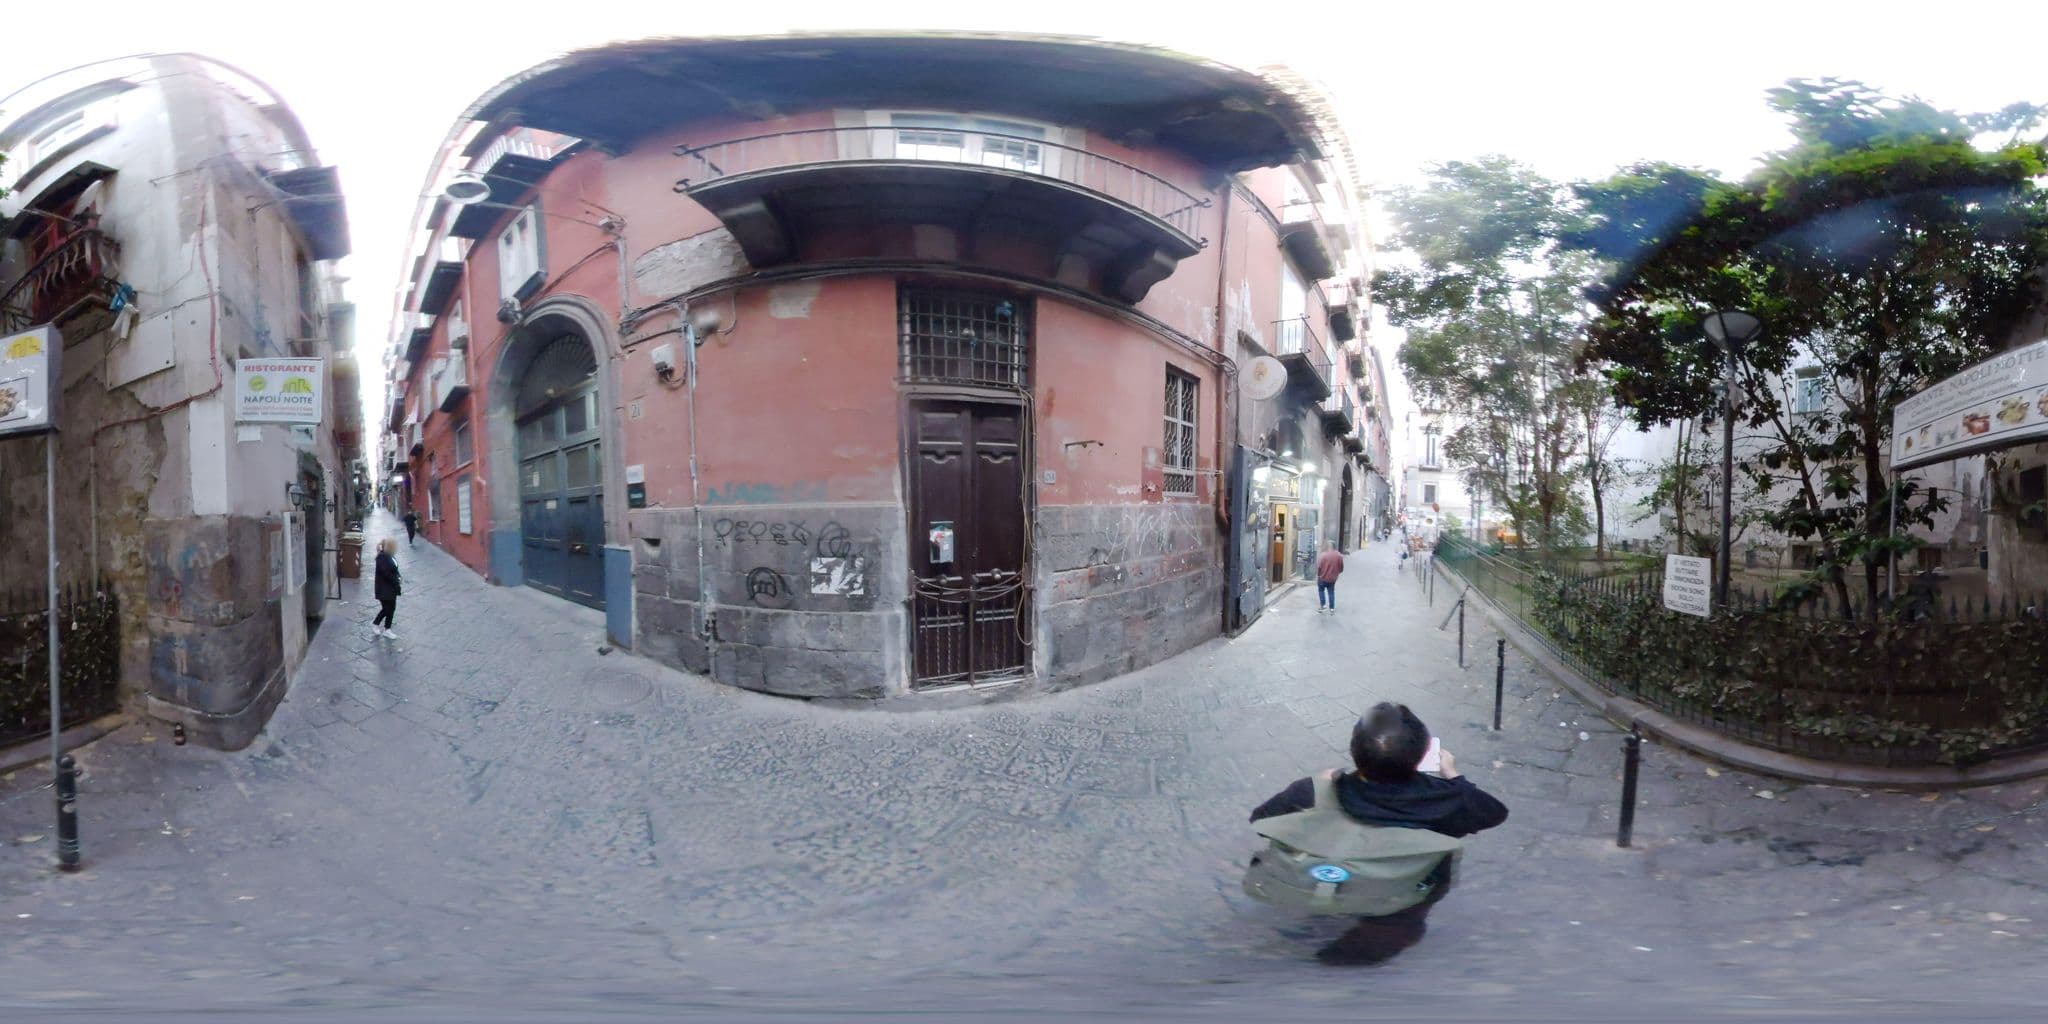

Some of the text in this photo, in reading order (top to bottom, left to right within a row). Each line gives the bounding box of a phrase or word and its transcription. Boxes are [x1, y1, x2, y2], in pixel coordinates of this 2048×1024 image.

[1995, 347, 2046, 371] NOTTE
[244, 365, 316, 373] RISTORANTE
[244, 395, 313, 404] NAPOLI NOTTE
